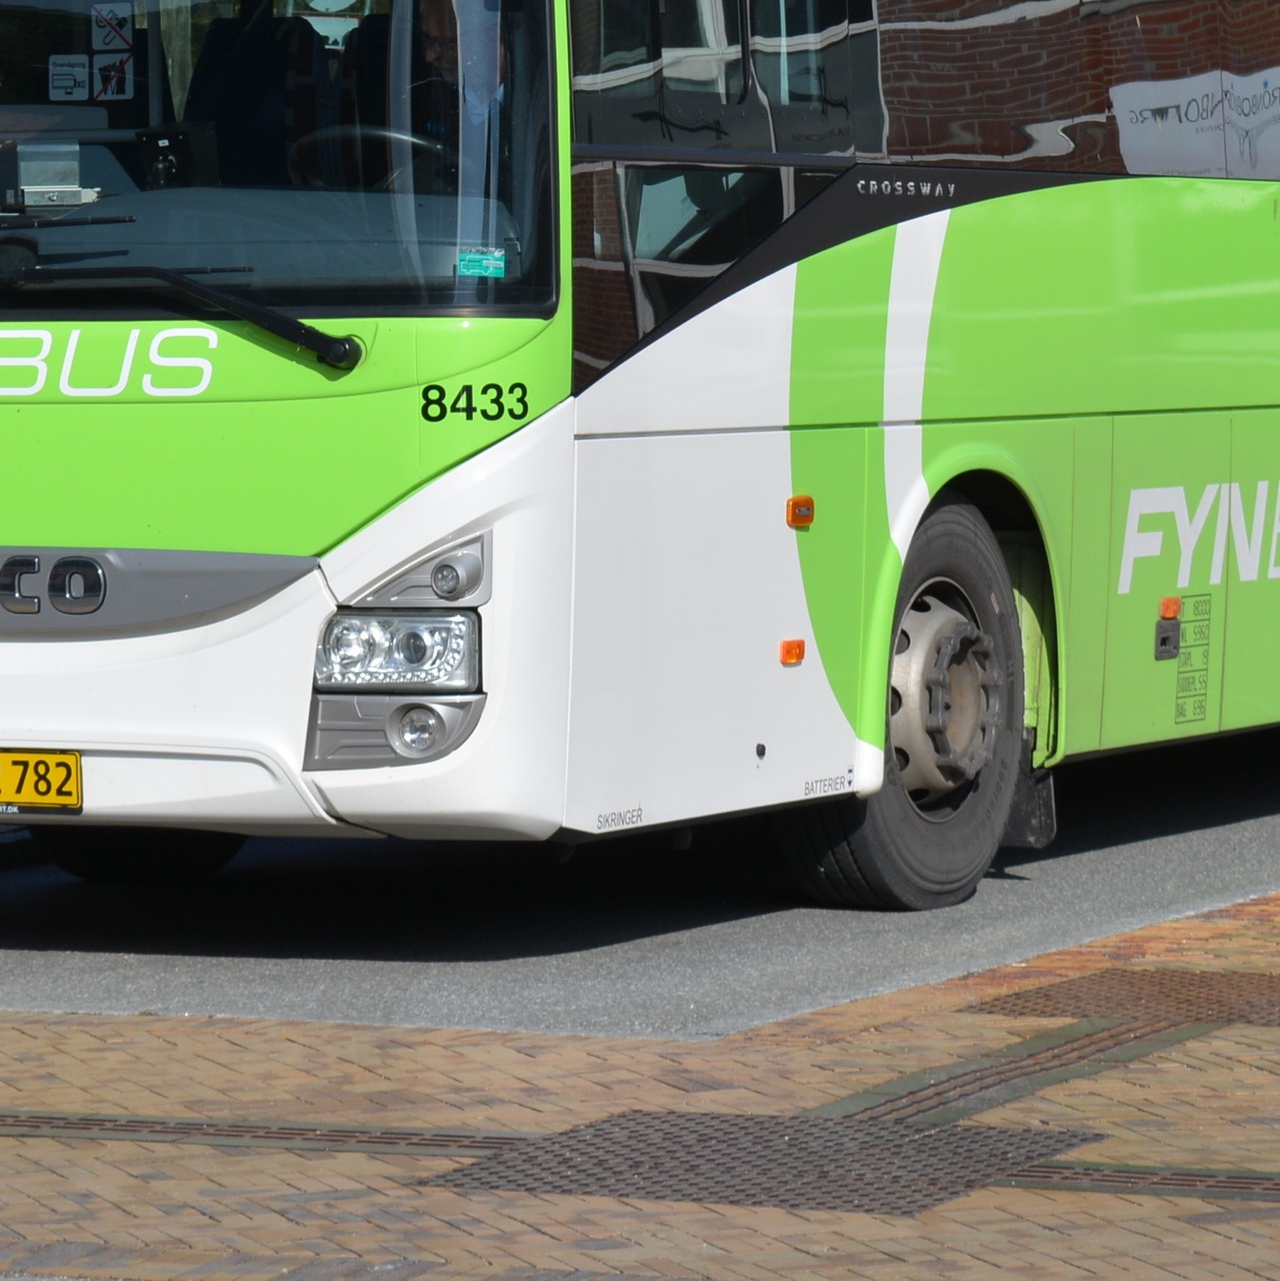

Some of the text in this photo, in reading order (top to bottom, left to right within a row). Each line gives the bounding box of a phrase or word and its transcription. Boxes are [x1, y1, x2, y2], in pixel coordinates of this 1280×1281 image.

[856, 180, 956, 198] CROSSWAY
[421, 381, 531, 423] 8433
[11, 759, 74, 797] 782
[803, 775, 846, 797] BATTERIER
[596, 806, 644, 831] SIKRINGER
